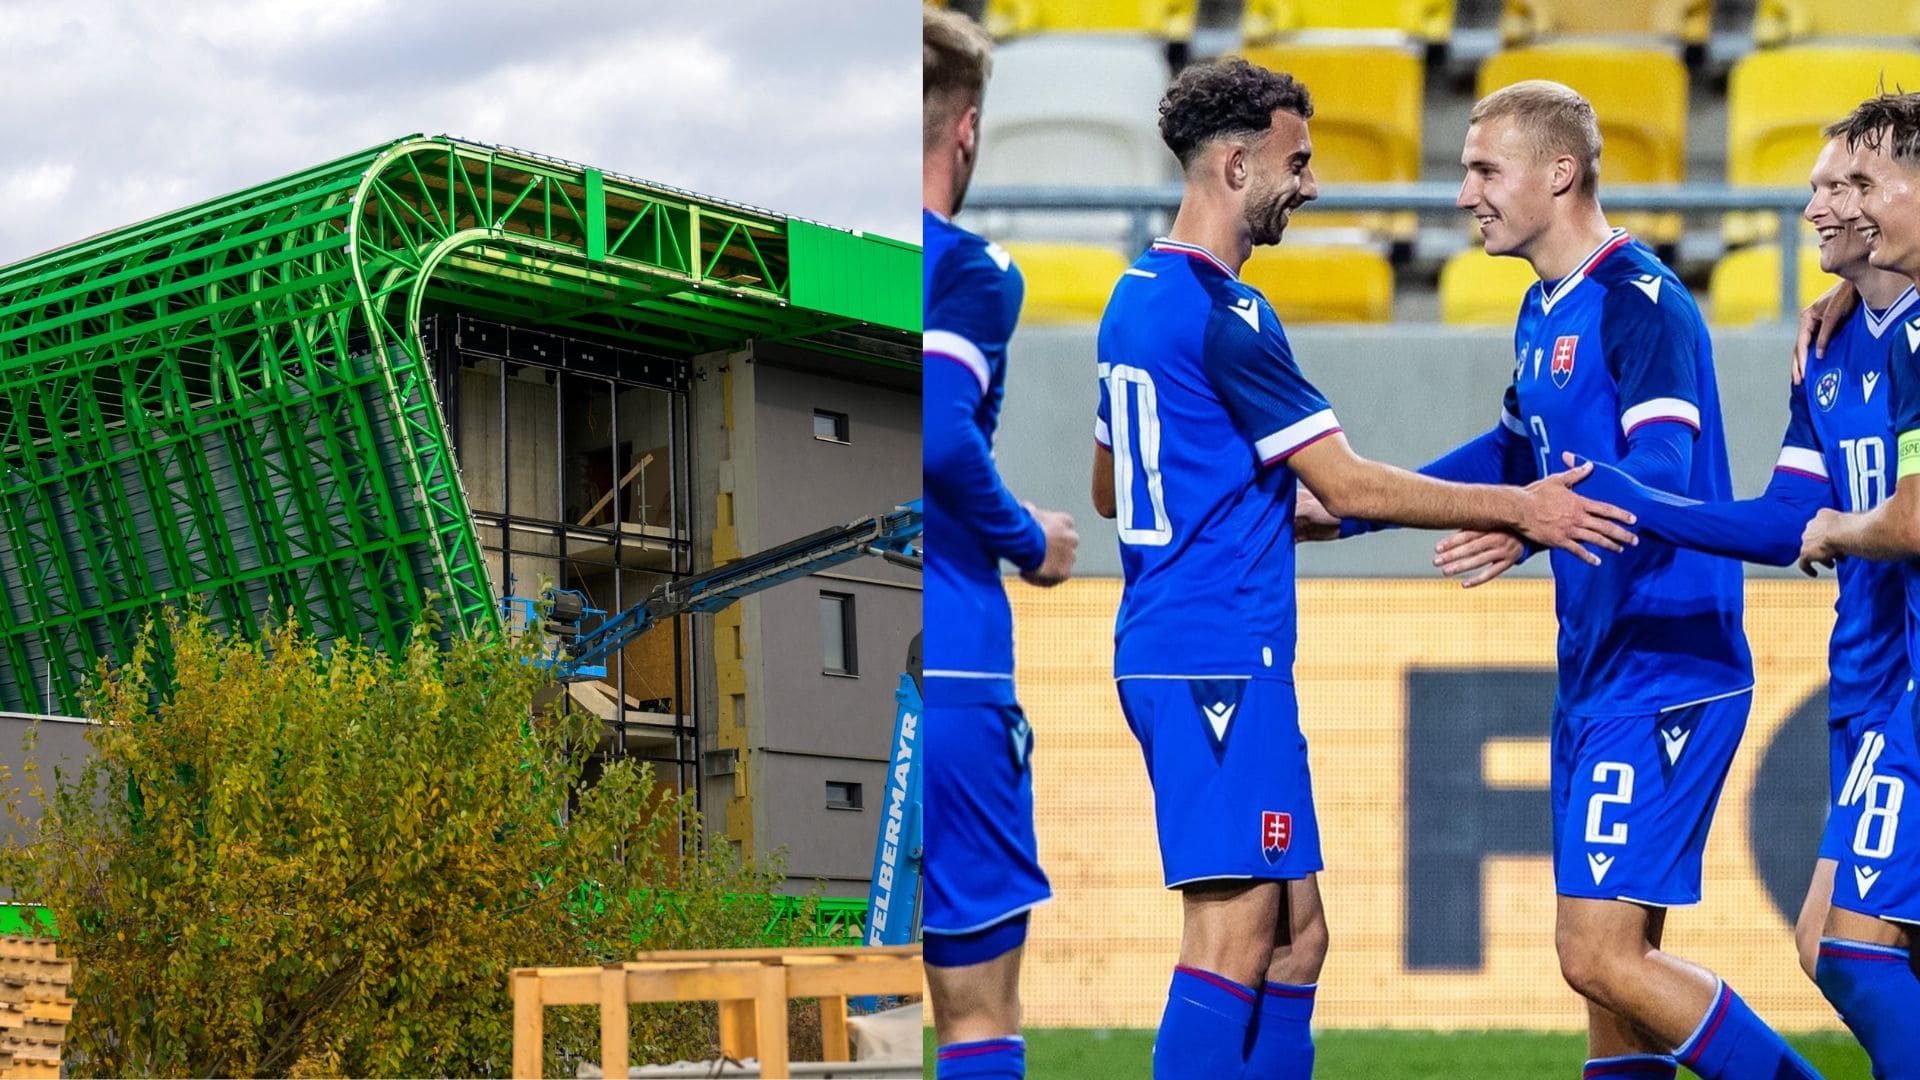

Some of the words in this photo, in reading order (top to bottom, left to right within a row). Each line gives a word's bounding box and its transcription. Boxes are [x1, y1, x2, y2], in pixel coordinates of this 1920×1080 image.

[1839, 436, 1886, 513] 18
[869, 711, 918, 946] FELBERMAYR
[1585, 762, 1635, 844] 2
[1853, 775, 1905, 859] 8
